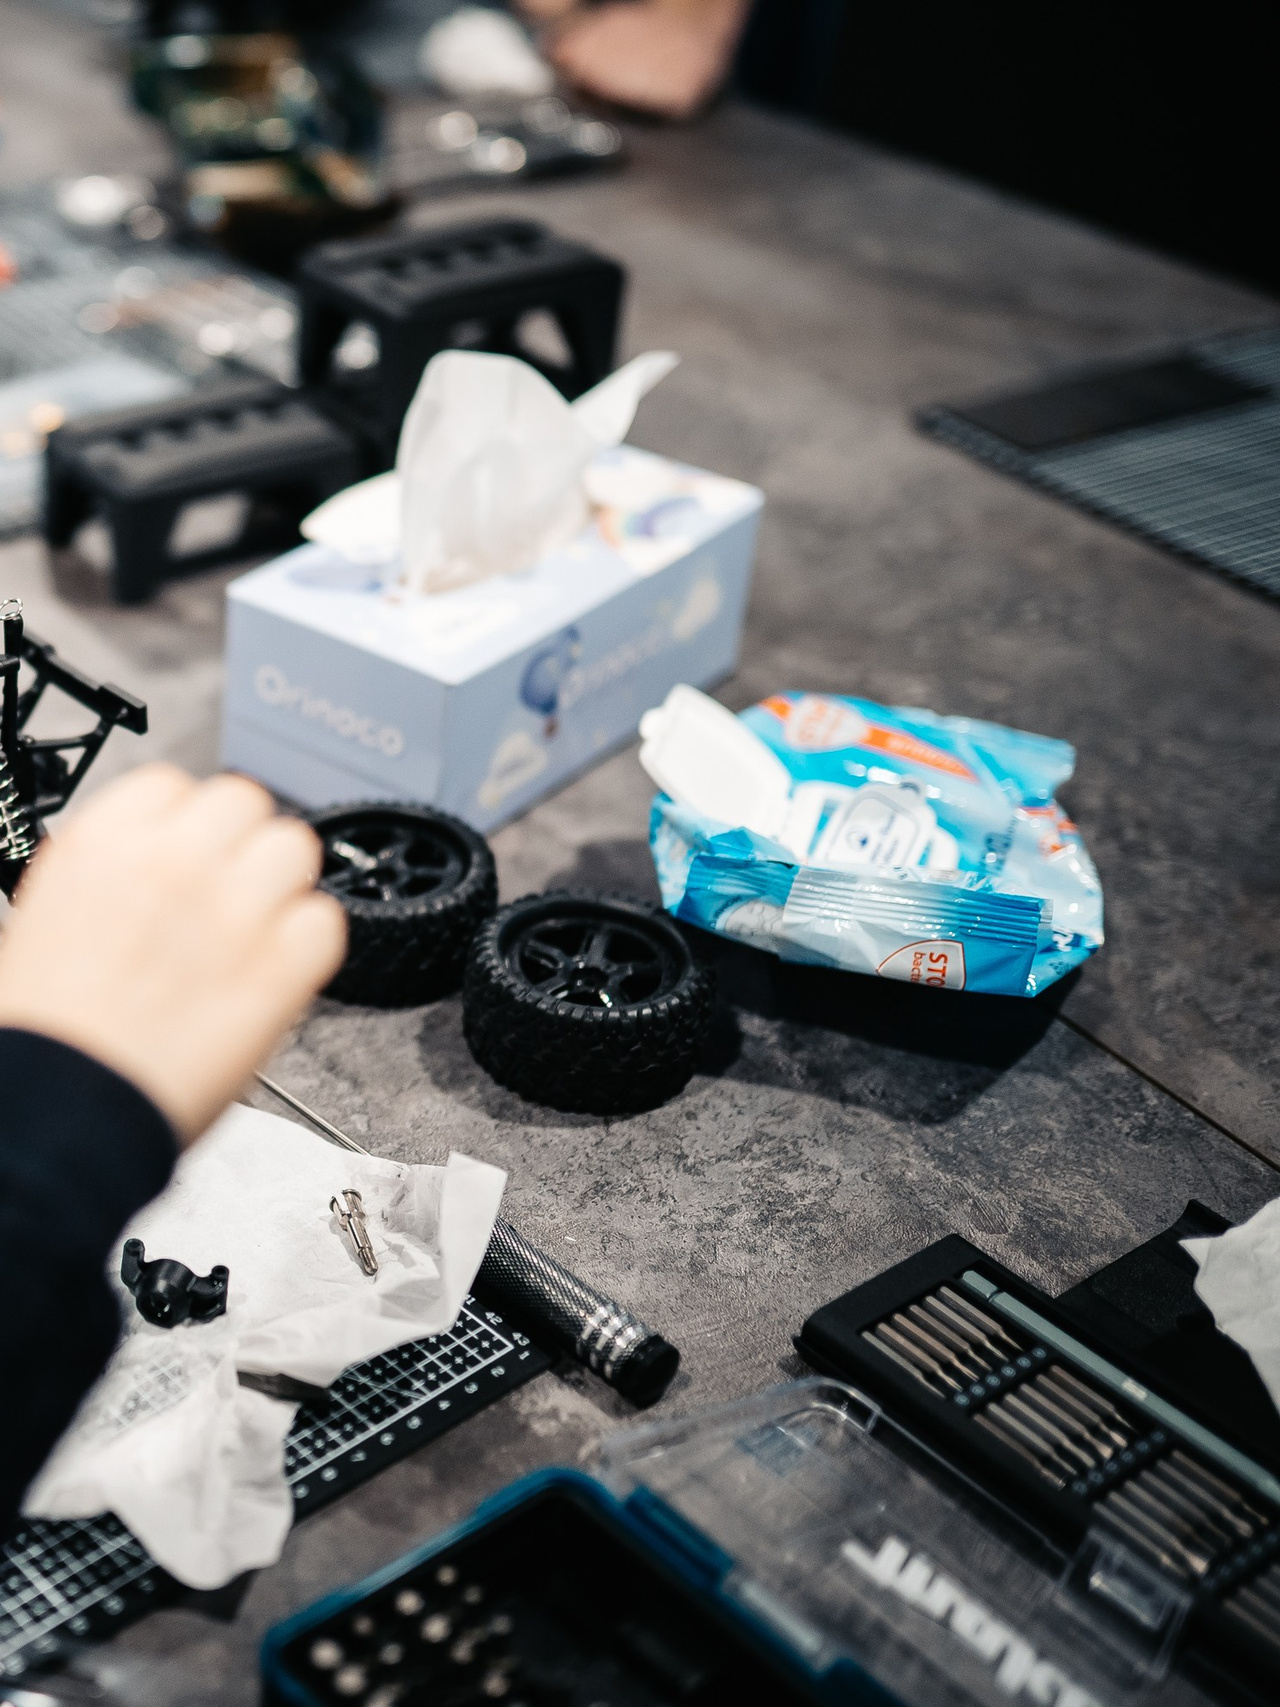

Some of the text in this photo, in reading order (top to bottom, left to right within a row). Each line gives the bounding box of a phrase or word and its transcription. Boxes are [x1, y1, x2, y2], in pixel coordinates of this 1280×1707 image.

[925, 951, 948, 986] STO
[484, 1311, 503, 1326] 42
[511, 1332, 531, 1347] 43
